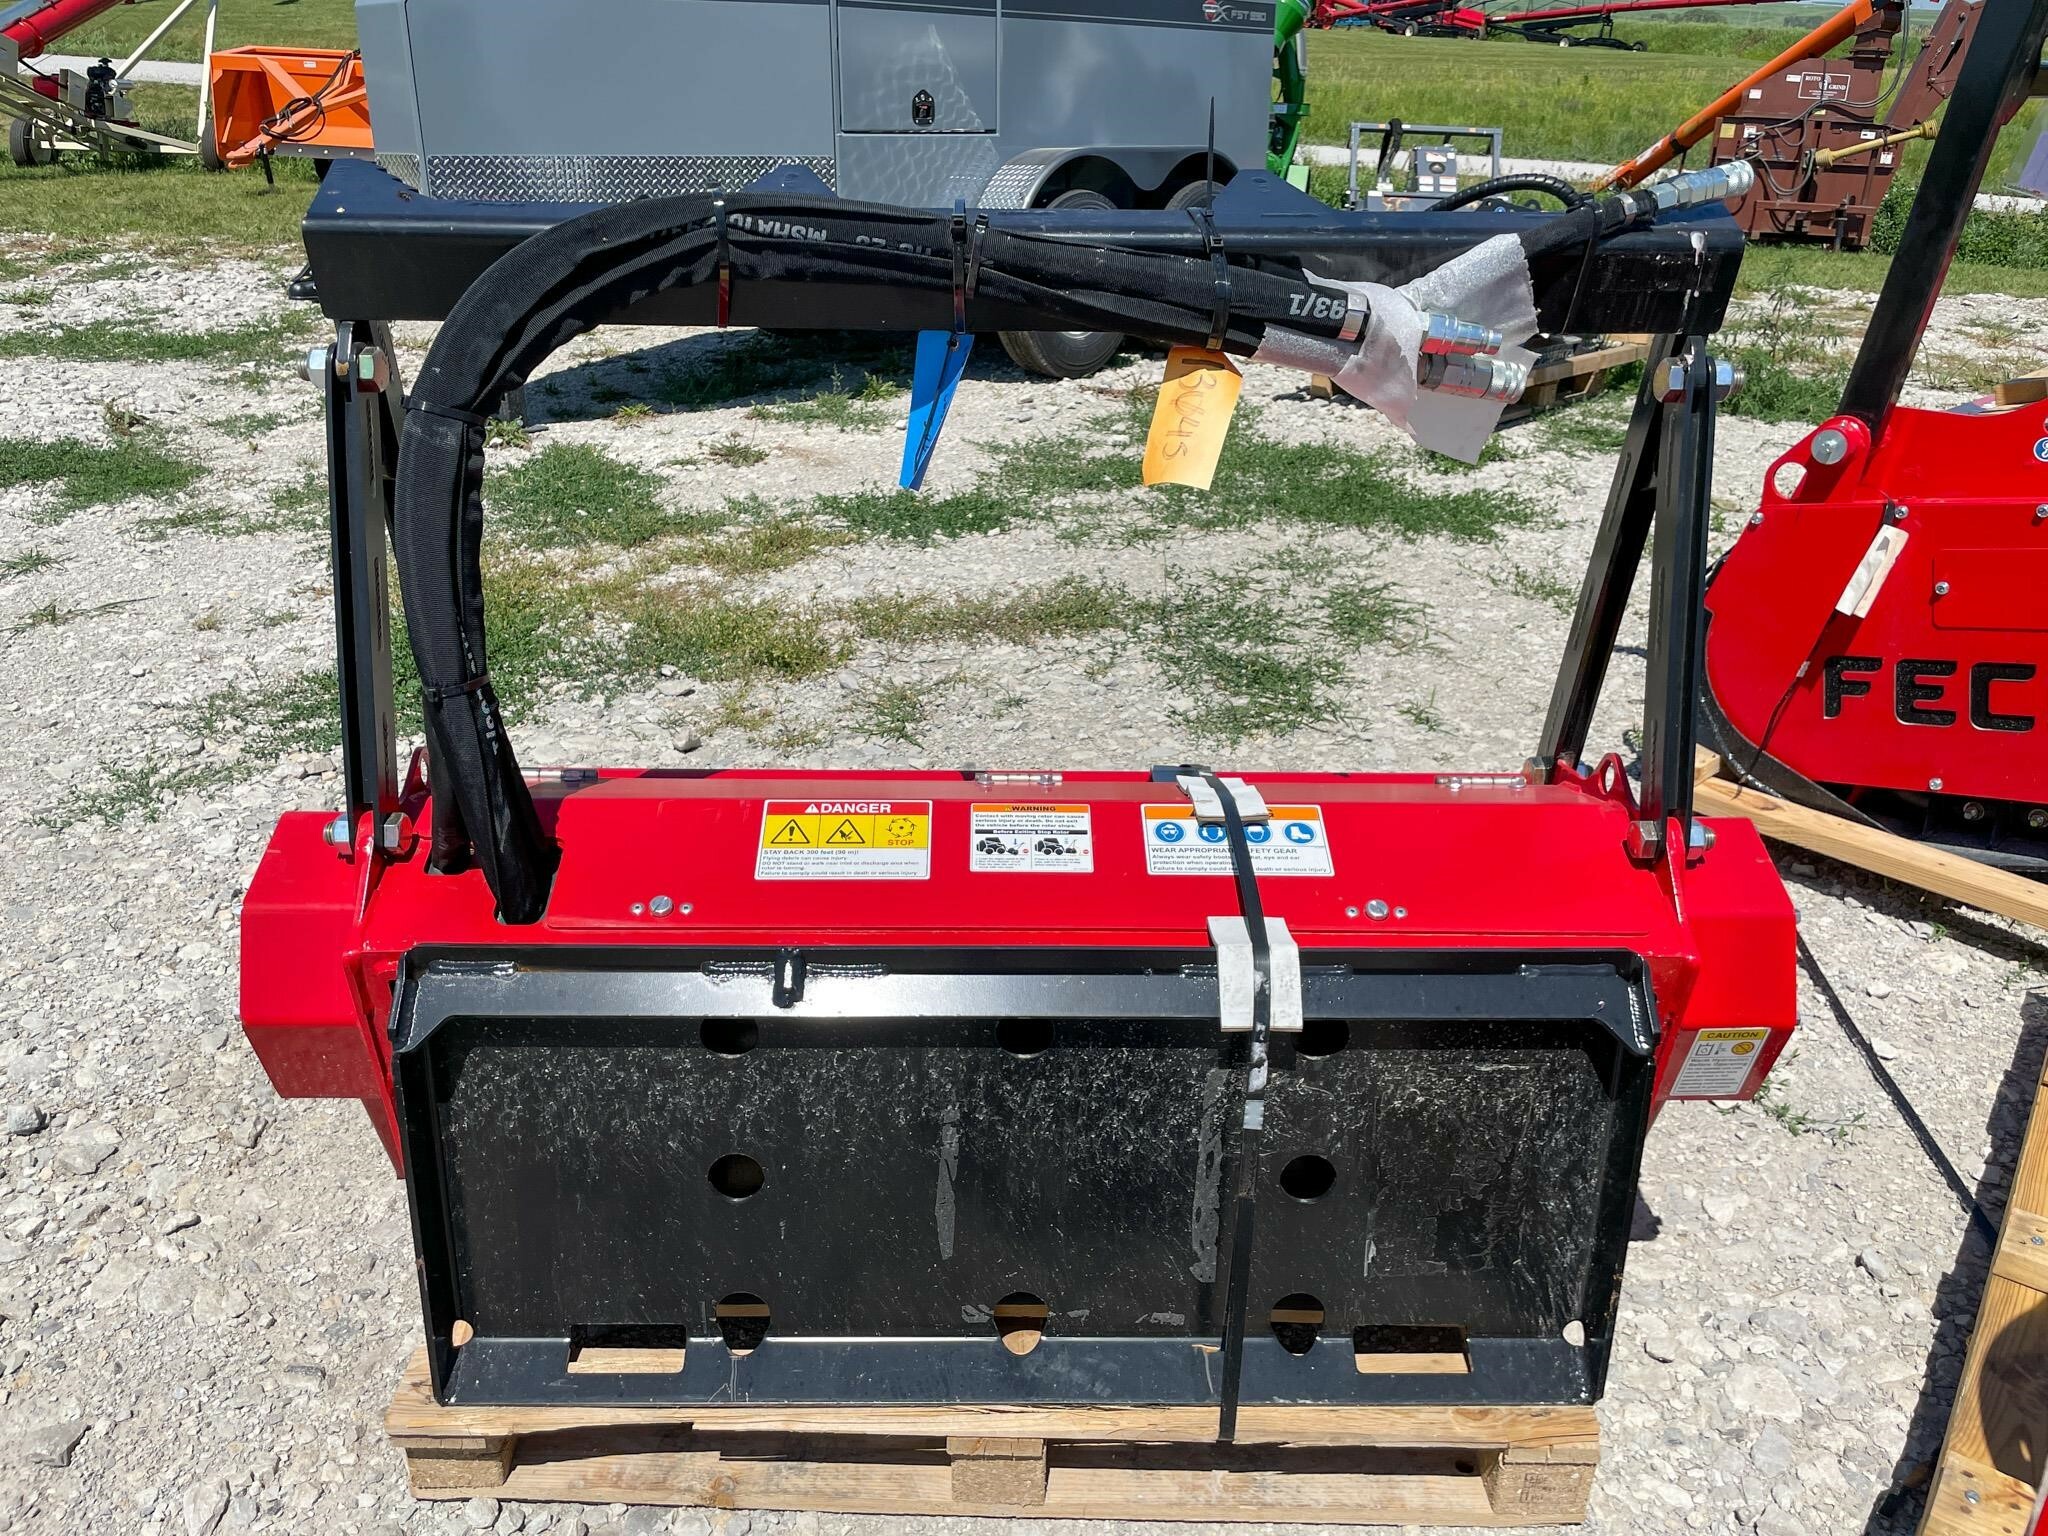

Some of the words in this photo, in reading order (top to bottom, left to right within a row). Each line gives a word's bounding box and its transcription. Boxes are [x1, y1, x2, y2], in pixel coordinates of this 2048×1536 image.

[1822, 655, 2038, 733] FEC
[820, 803, 892, 814] DANGER
[1706, 1031, 1760, 1040] CAUTION
